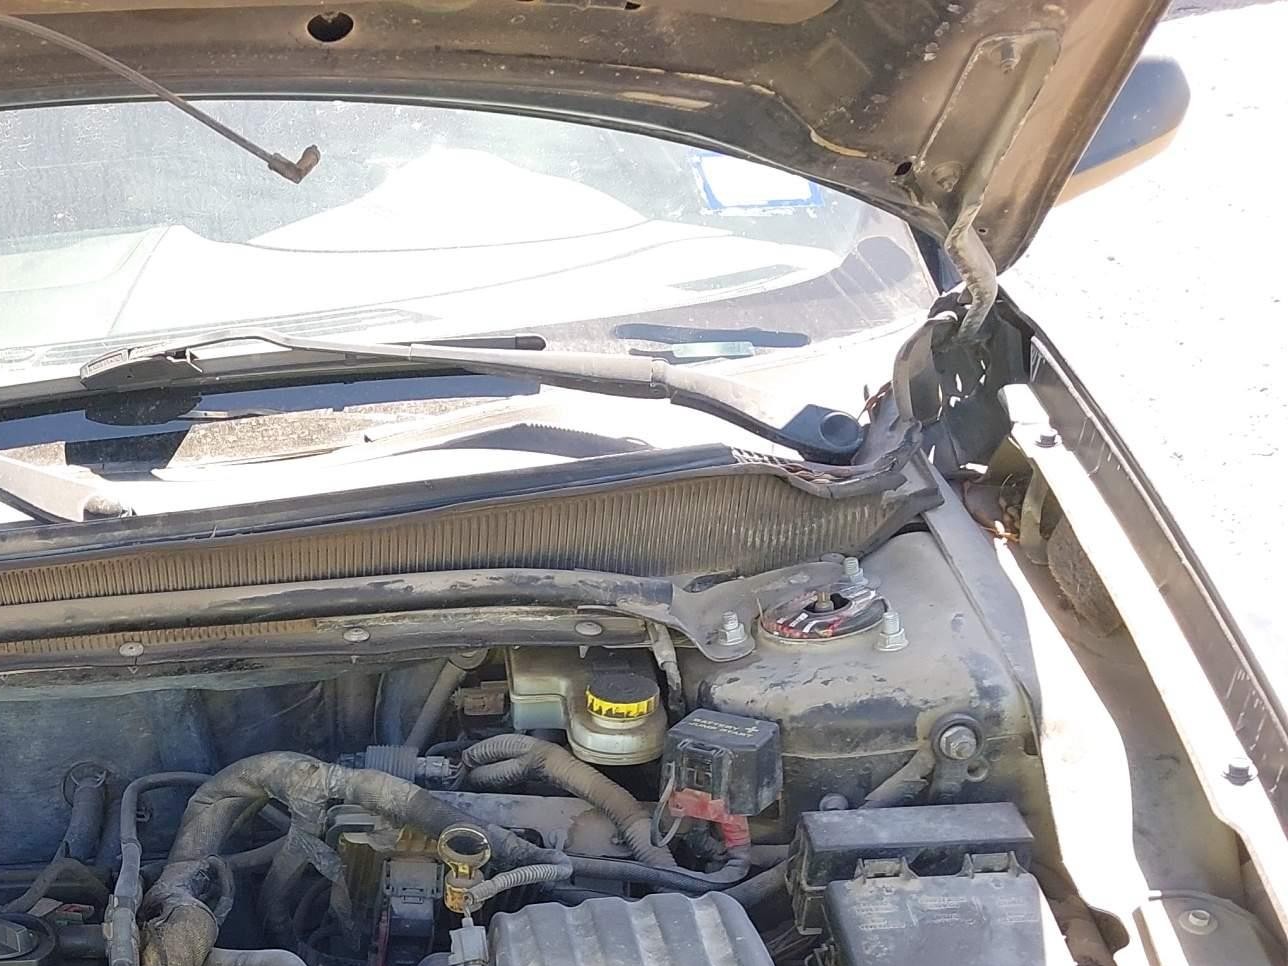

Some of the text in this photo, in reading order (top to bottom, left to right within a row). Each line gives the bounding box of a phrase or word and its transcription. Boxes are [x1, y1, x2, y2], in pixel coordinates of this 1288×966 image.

[688, 722, 754, 738] JUMP START
[692, 718, 739, 731] BATTERY
